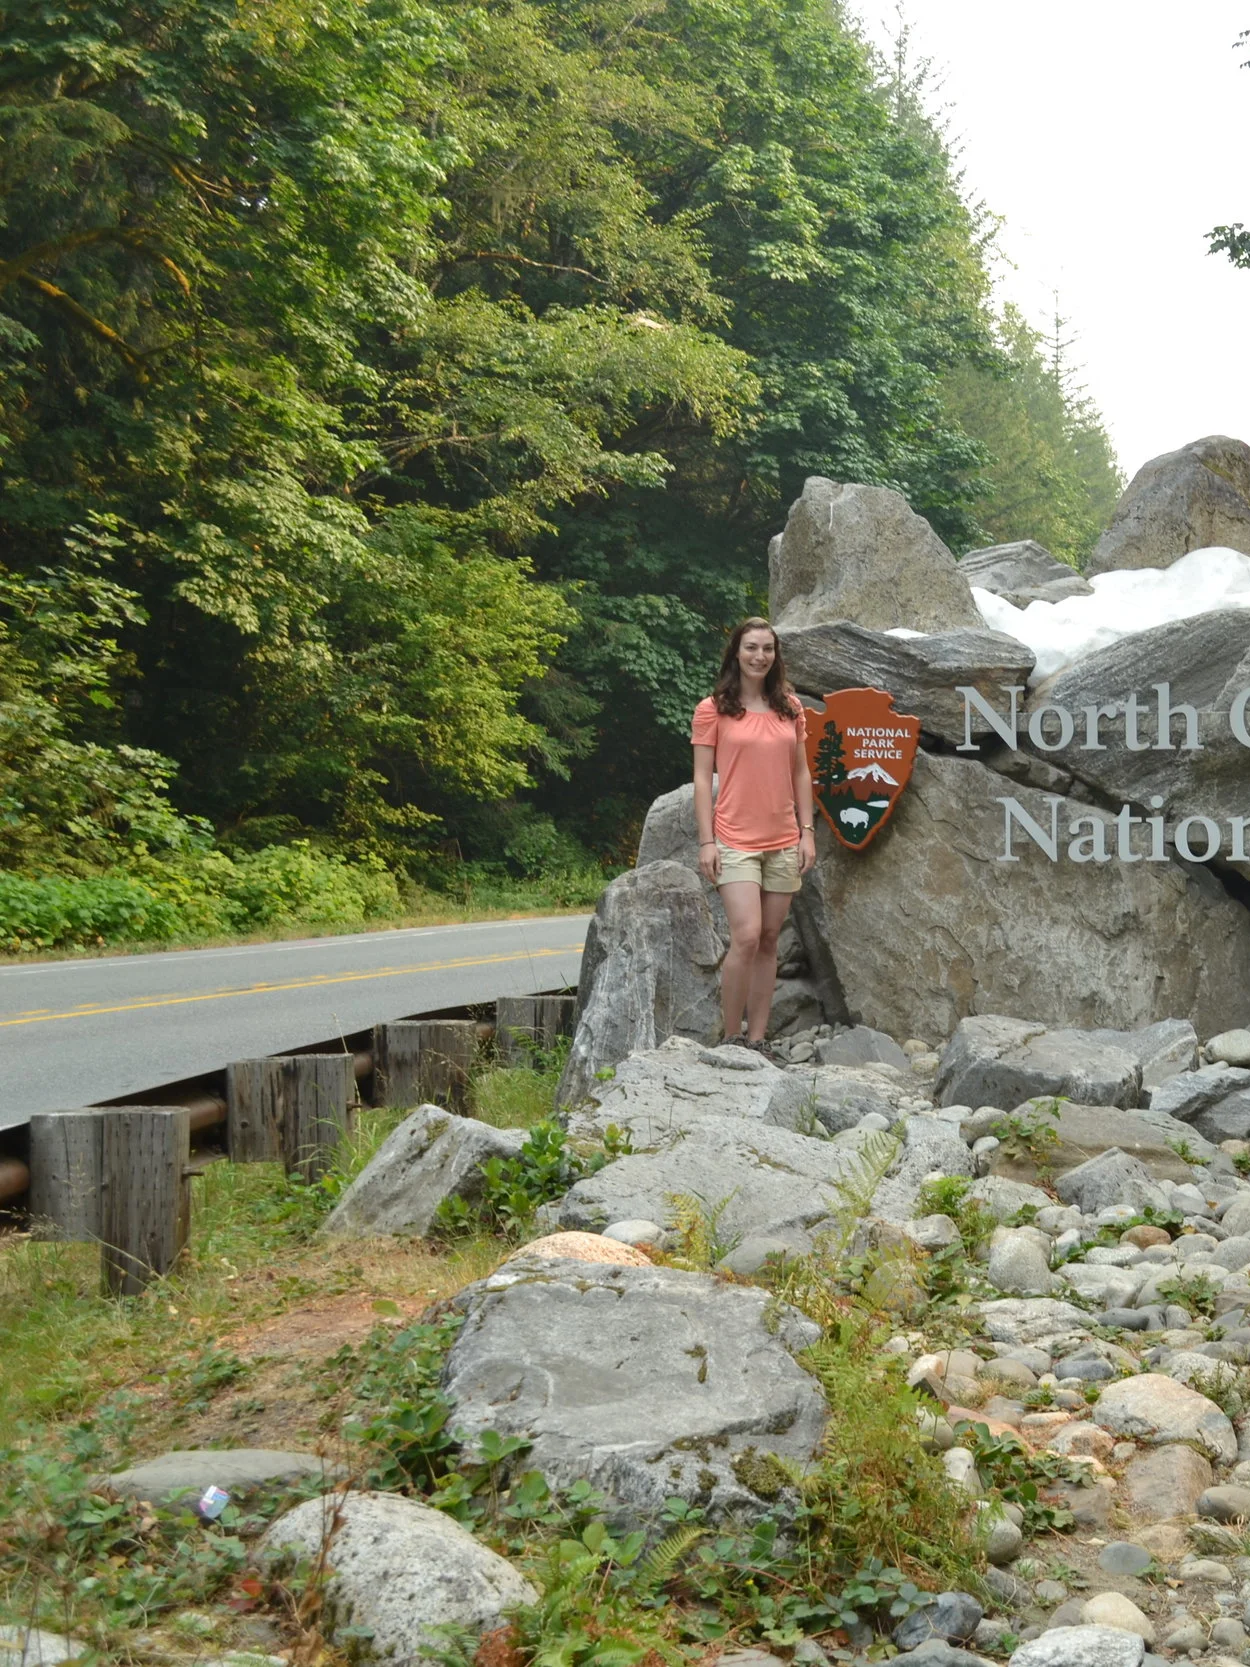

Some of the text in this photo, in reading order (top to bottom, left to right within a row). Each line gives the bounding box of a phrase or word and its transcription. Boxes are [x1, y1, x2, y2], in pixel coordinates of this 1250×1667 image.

[956, 682, 1204, 752] North
[847, 728, 911, 738] NATIONAL
[862, 738, 894, 748] PARK
[854, 749, 902, 760] SERVICE
